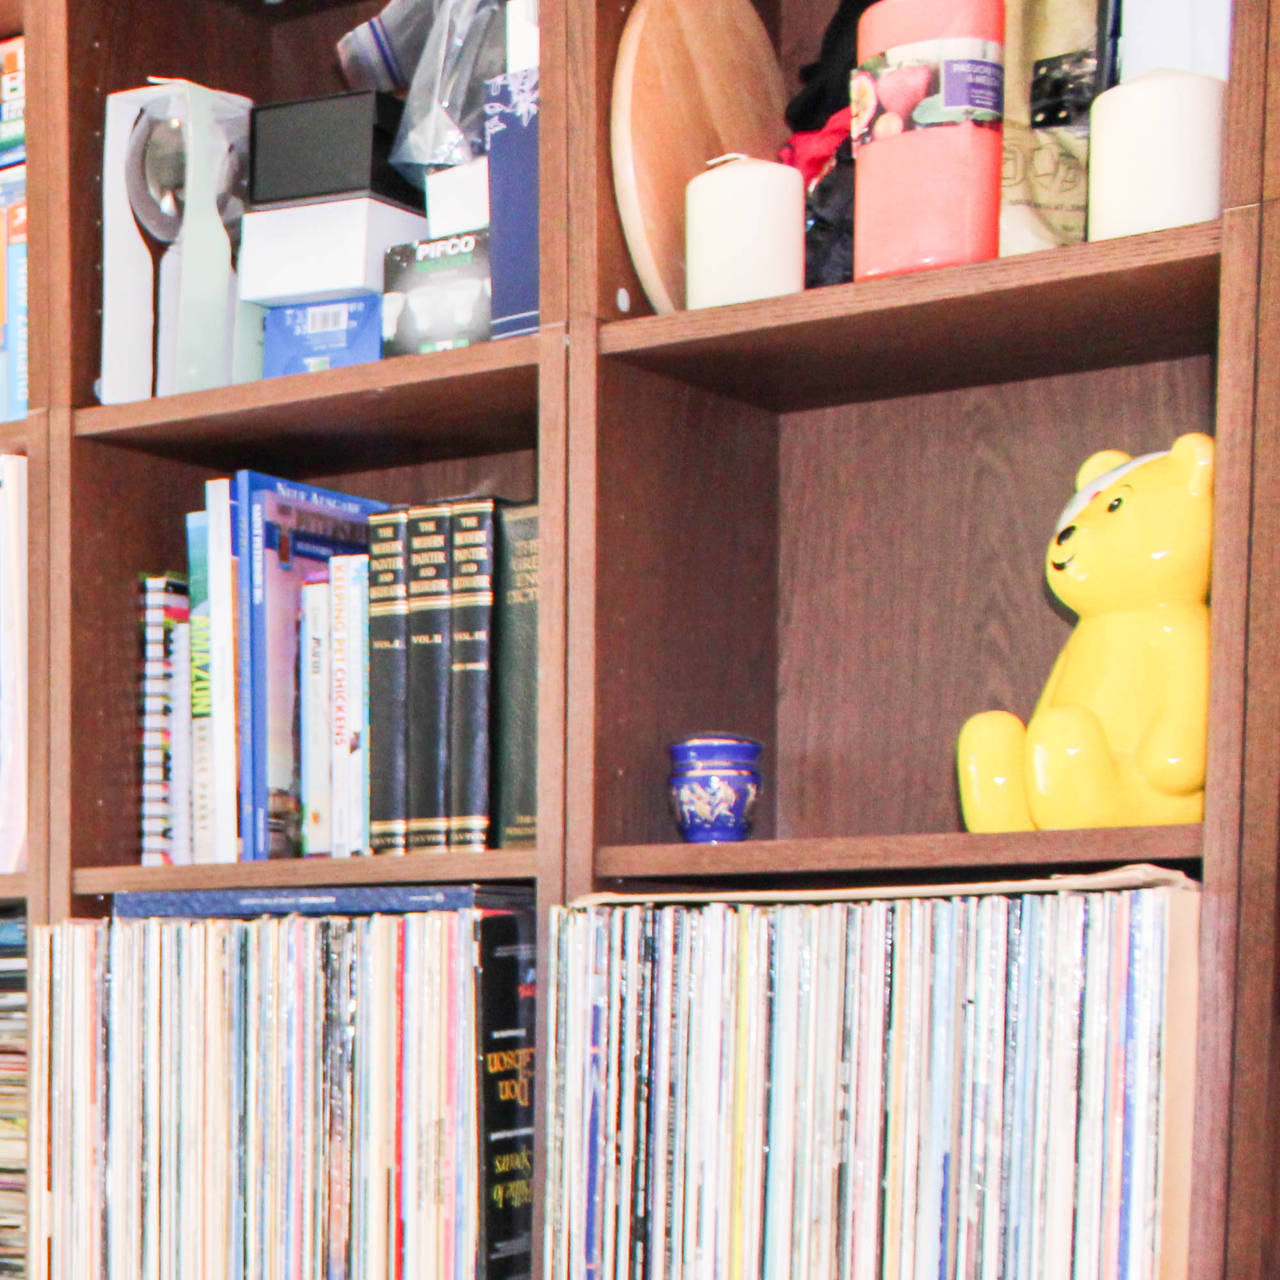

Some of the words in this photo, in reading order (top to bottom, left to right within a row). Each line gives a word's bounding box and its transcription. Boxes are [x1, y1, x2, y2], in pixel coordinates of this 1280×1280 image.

[416, 234, 477, 260] PIFCO
[333, 565, 347, 634] KEEPING
[191, 616, 212, 716] AMAZON
[333, 639, 347, 665] PET
[333, 668, 347, 748] CHICKENS
